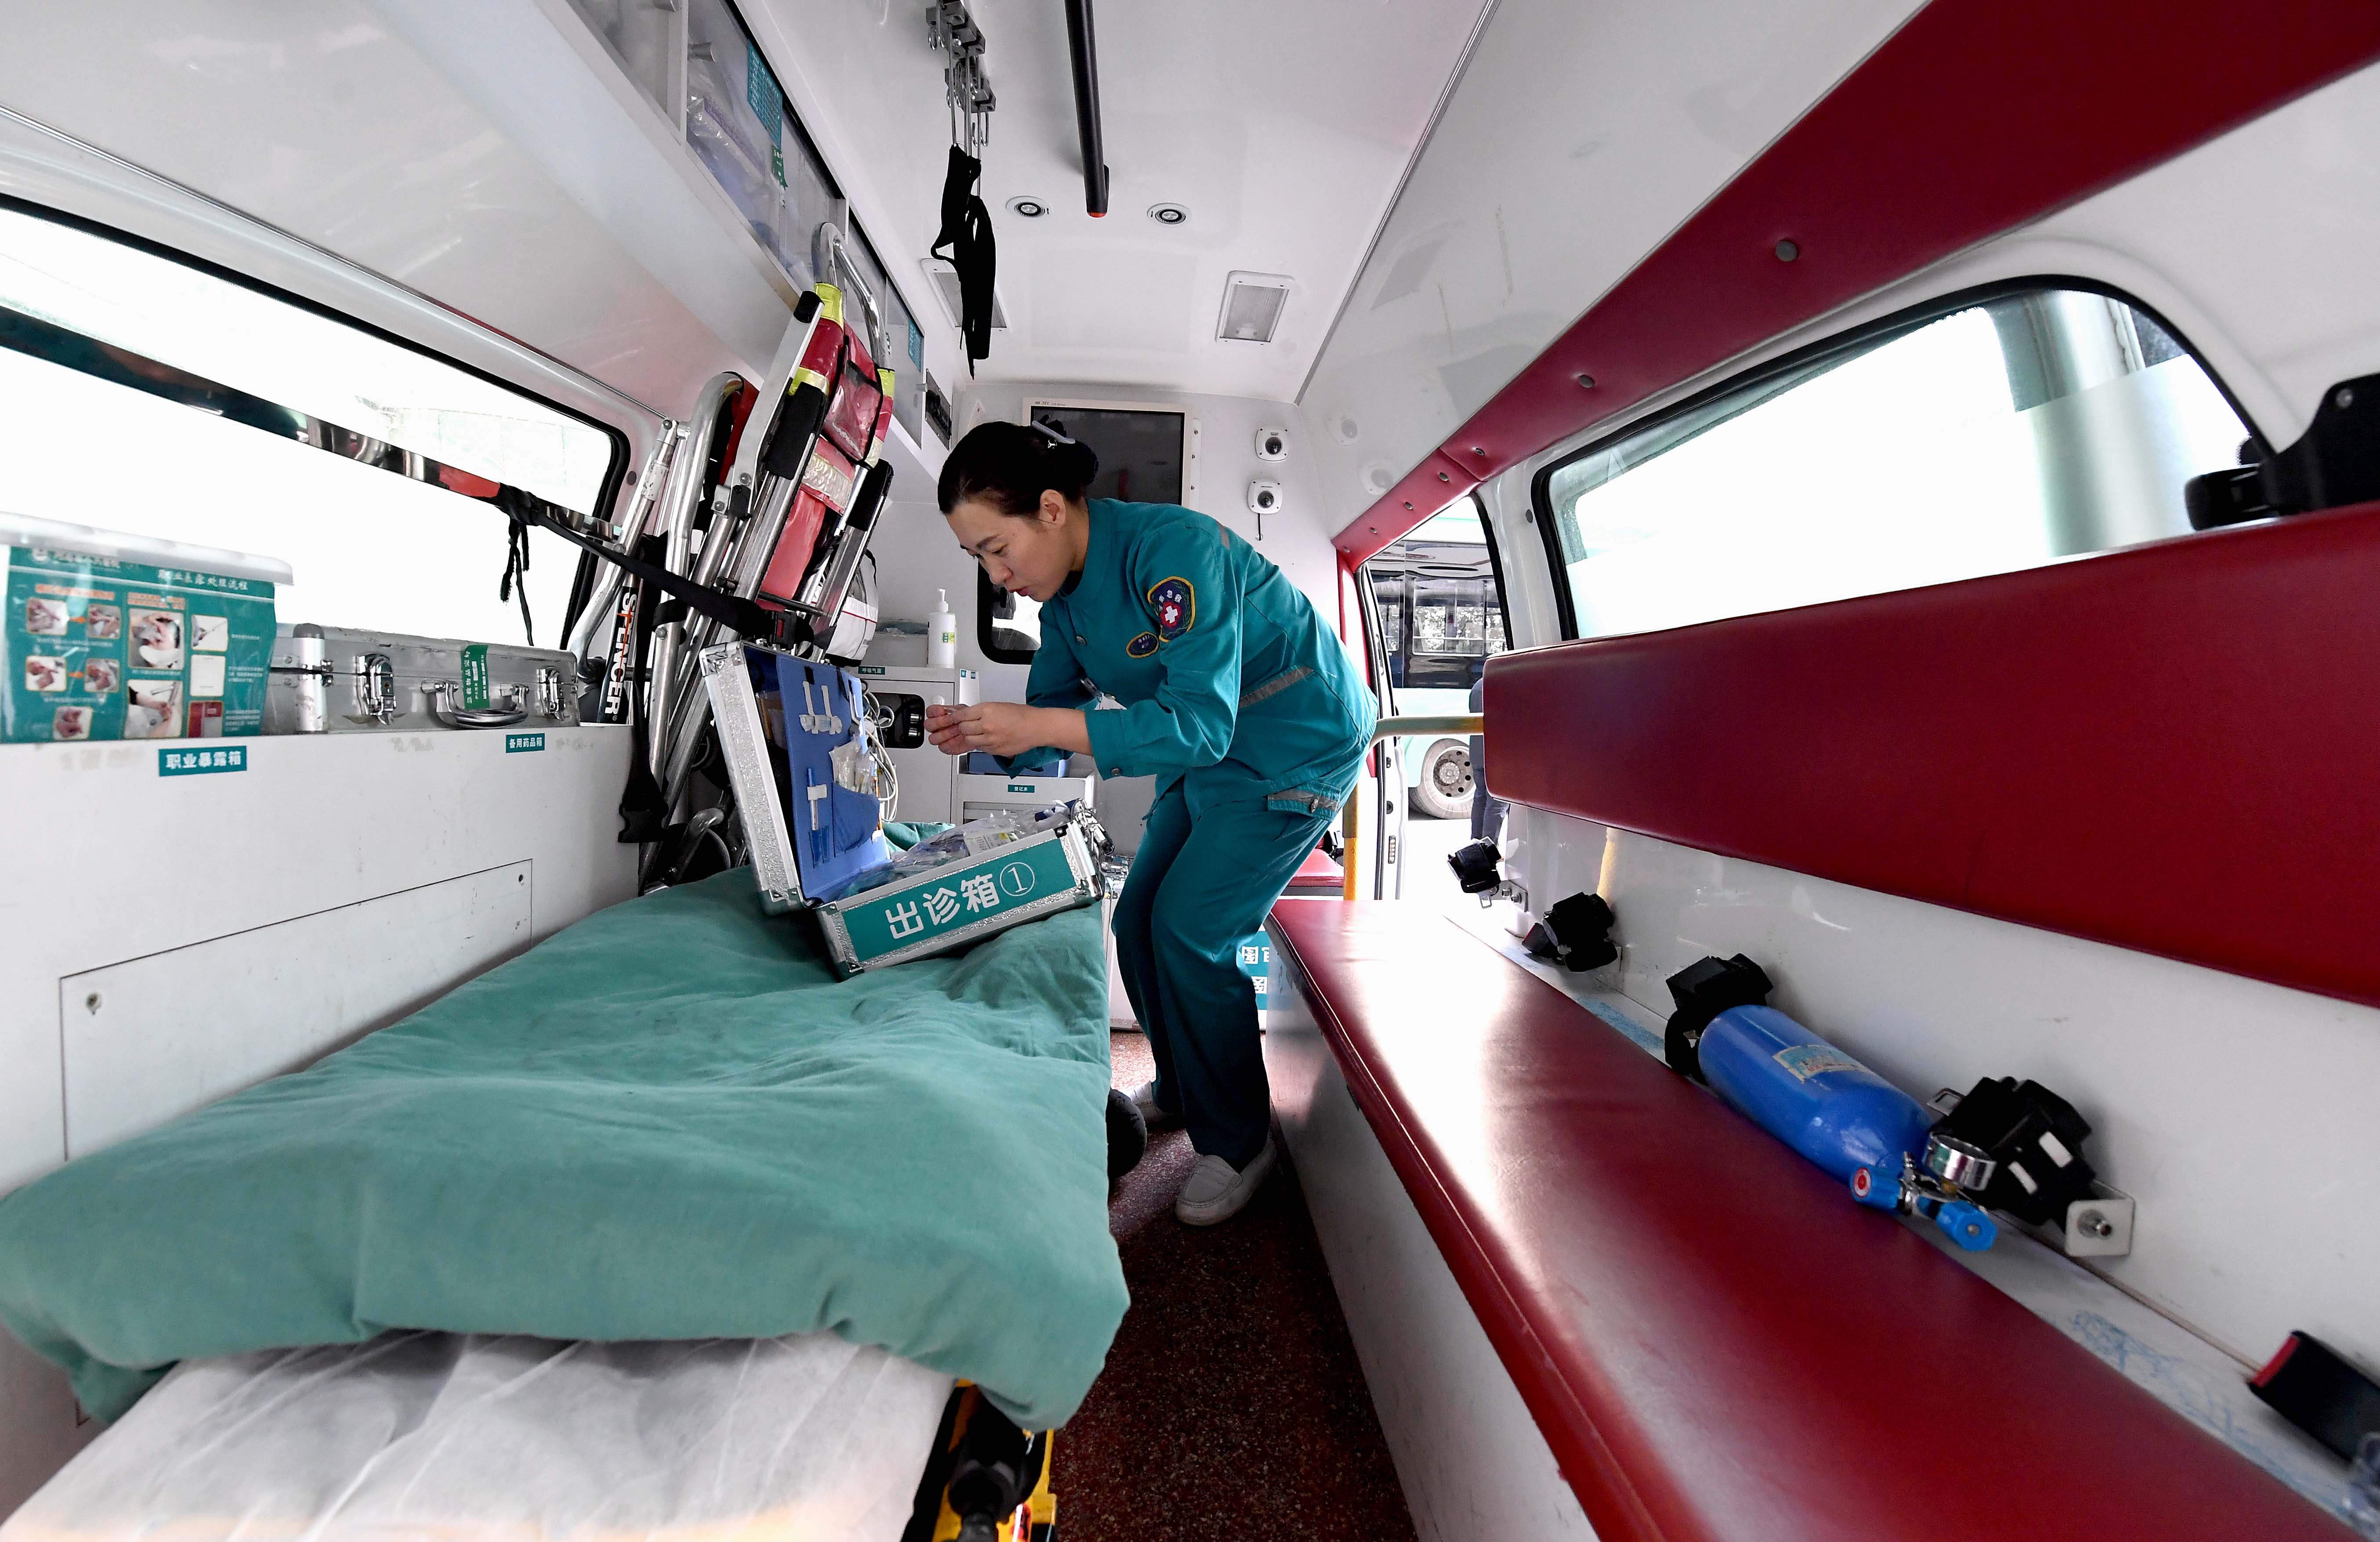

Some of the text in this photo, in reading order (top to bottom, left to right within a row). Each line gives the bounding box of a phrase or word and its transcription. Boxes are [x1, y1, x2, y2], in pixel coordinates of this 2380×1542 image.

[604, 592, 637, 714] SPENCER
[509, 737, 542, 748] 备用药品箱
[166, 751, 241, 769] 职业暴露箱
